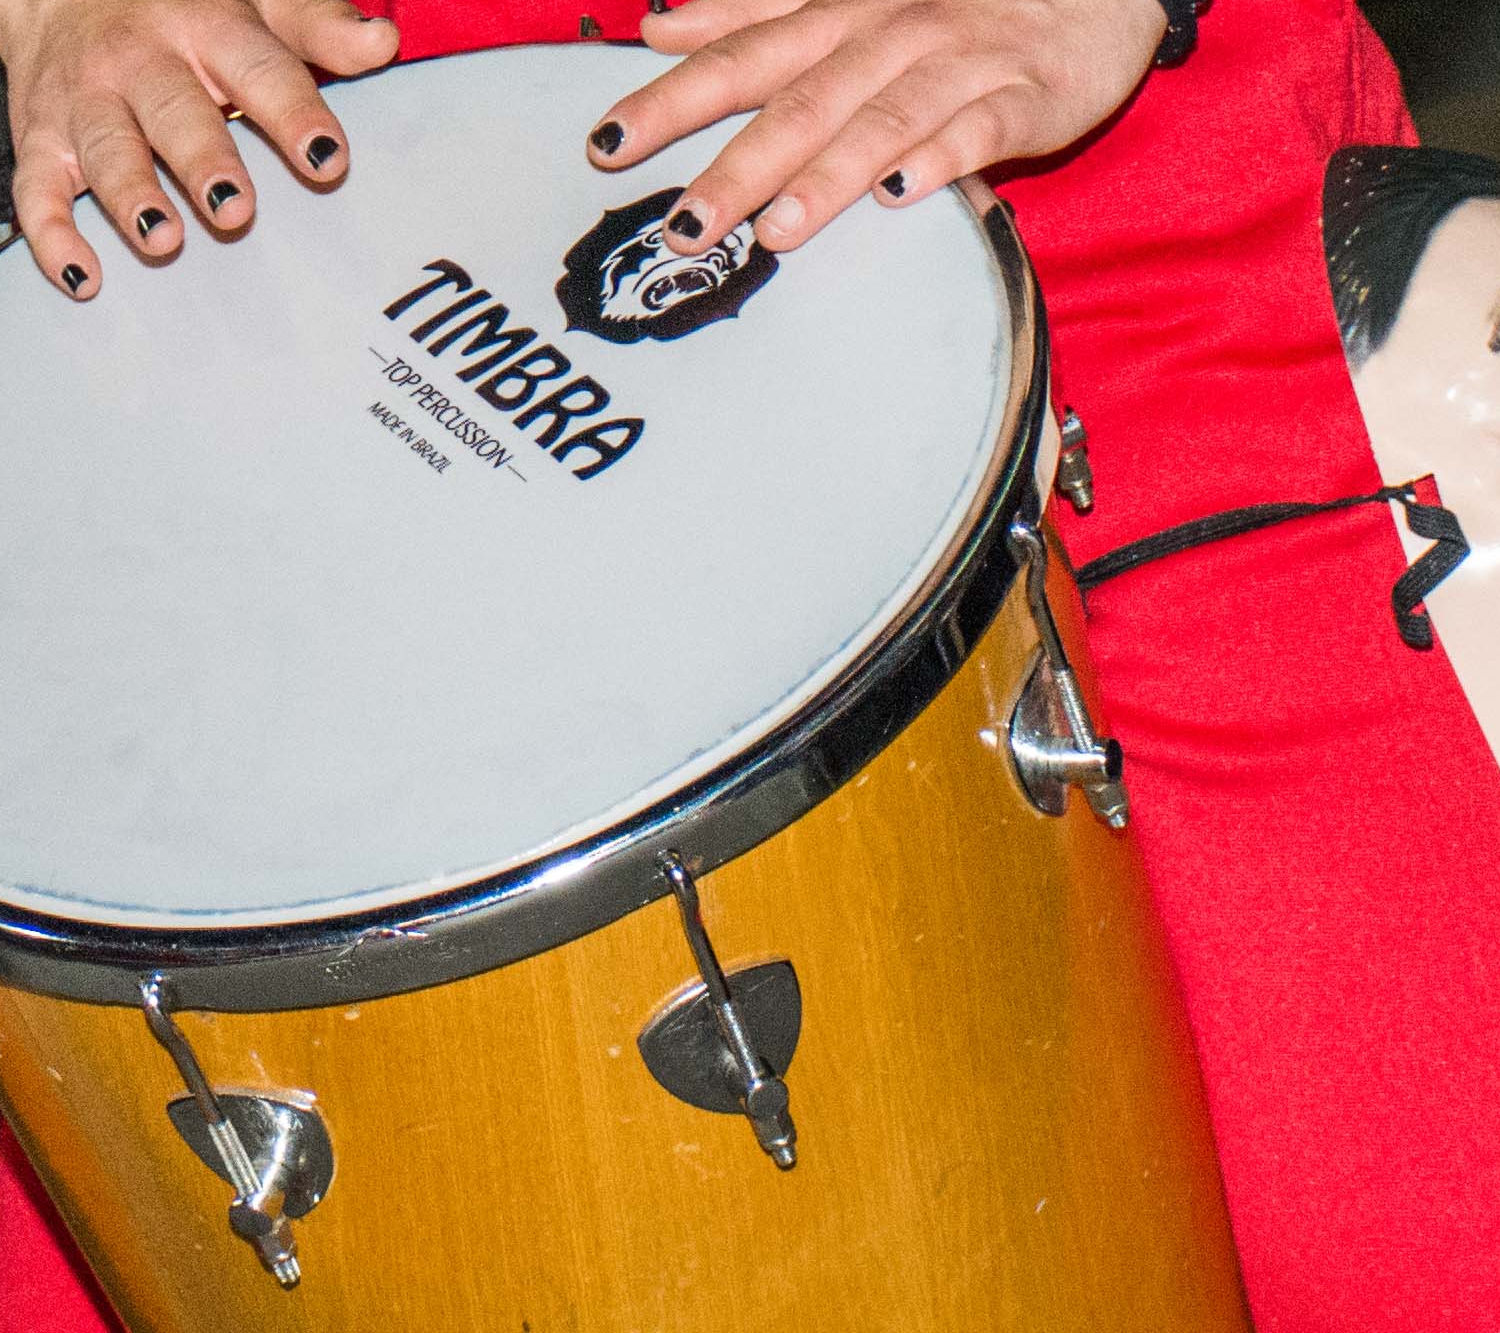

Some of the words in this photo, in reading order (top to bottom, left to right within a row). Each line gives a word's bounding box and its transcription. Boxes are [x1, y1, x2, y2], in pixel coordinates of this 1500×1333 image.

[381, 357, 422, 387] TOP
[409, 383, 514, 468] PERCUSSION
[383, 258, 645, 480] TIMBRA
[368, 401, 406, 433] MADE
[397, 427, 418, 444] IN
[410, 438, 452, 474] BRAZIL
